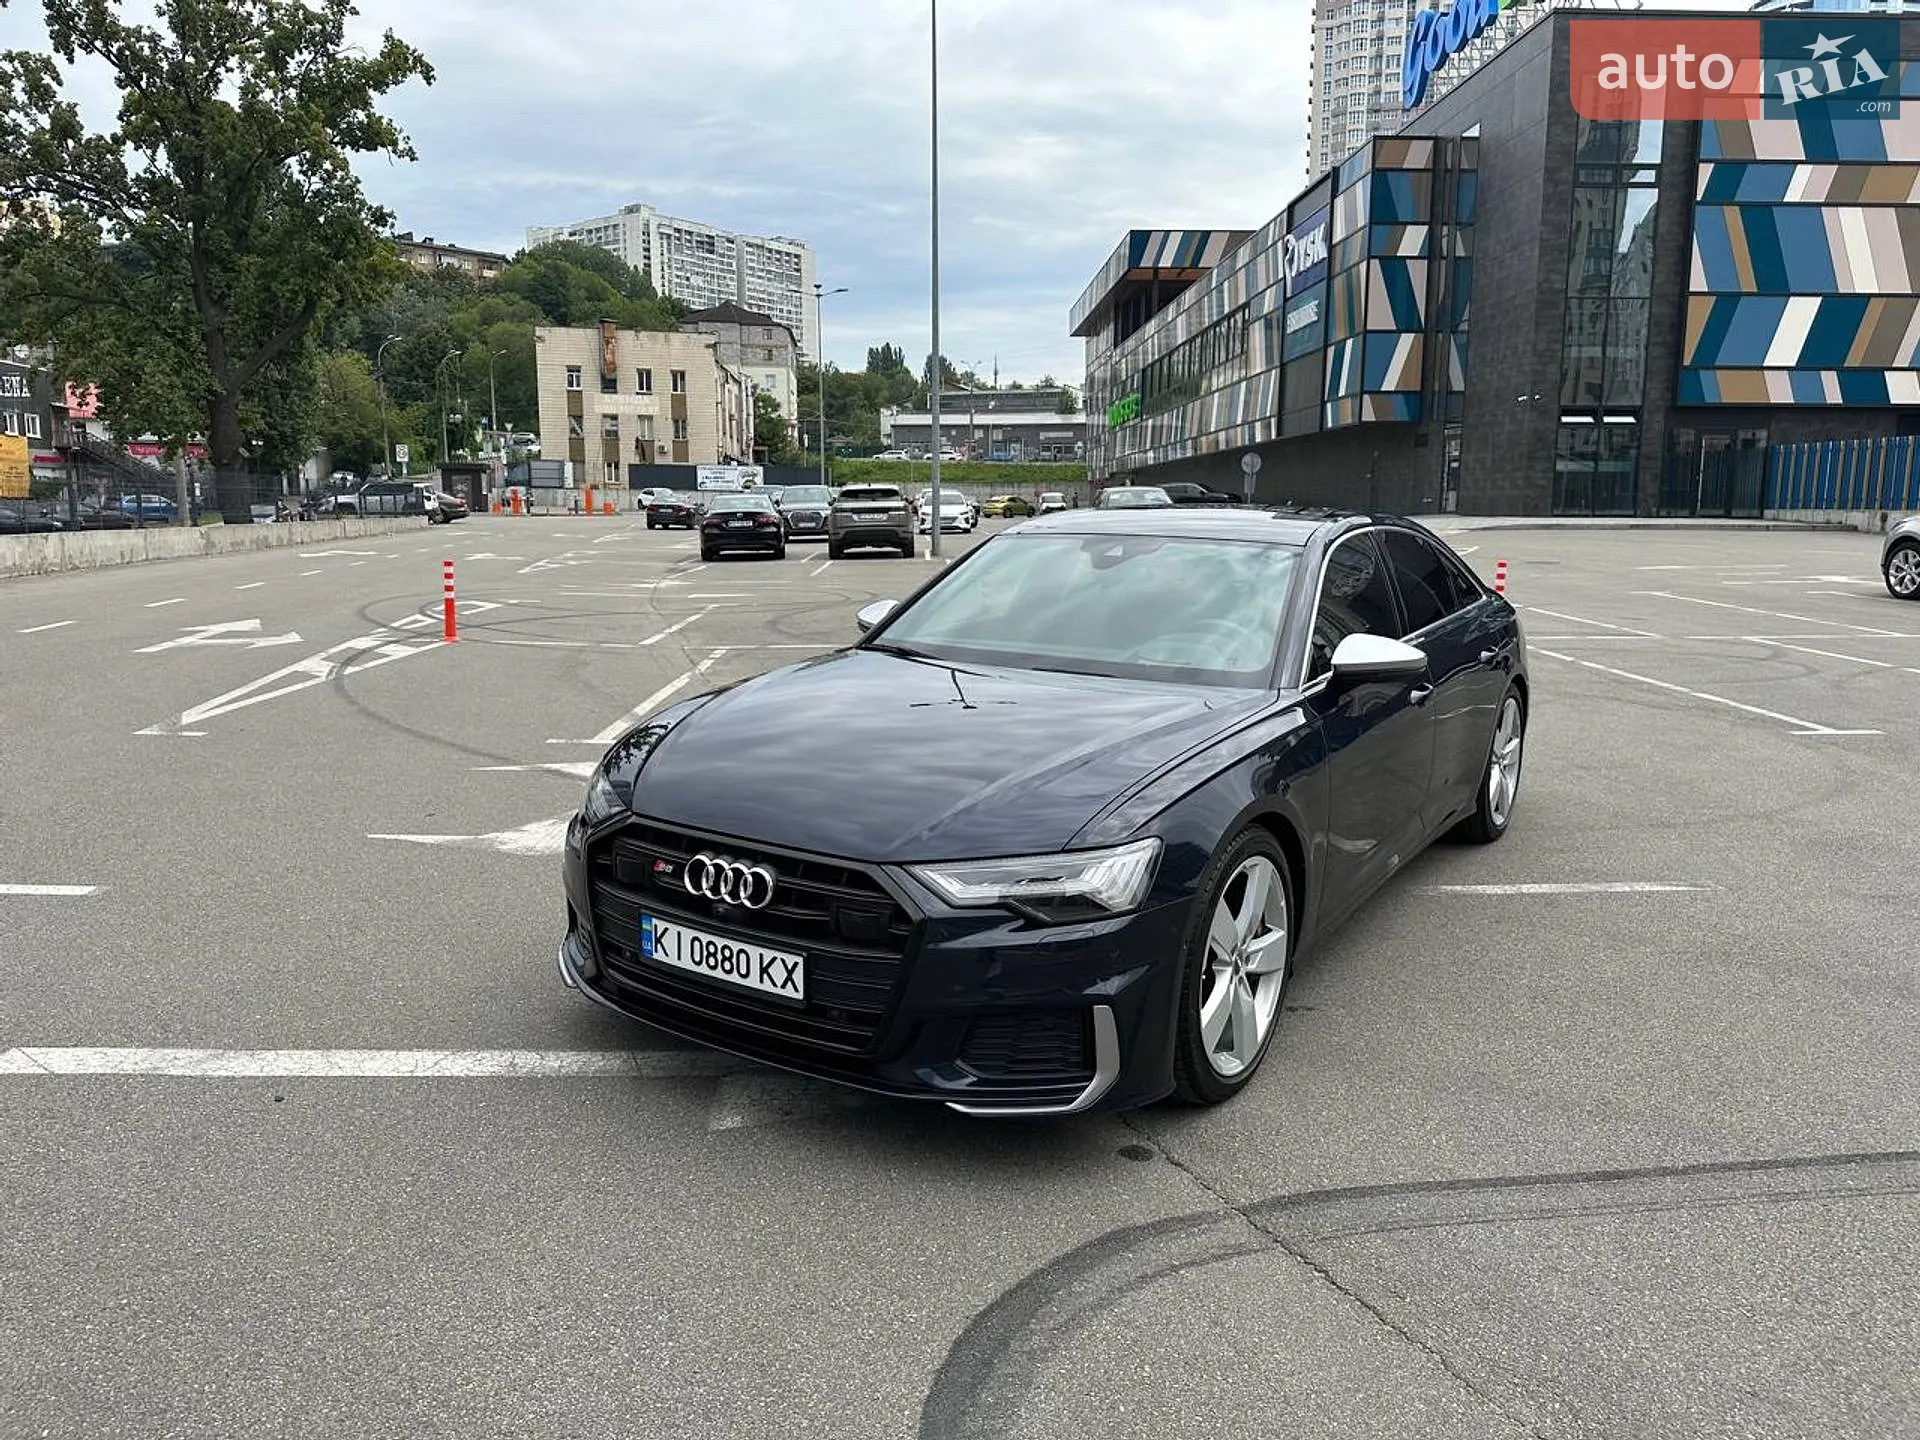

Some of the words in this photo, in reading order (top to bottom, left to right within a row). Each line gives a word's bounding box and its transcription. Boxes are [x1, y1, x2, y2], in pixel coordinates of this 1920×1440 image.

[0, 376, 31, 397] ENA
[653, 924, 682, 962] KI
[690, 936, 751, 979] 0880
[759, 952, 800, 993] KX
